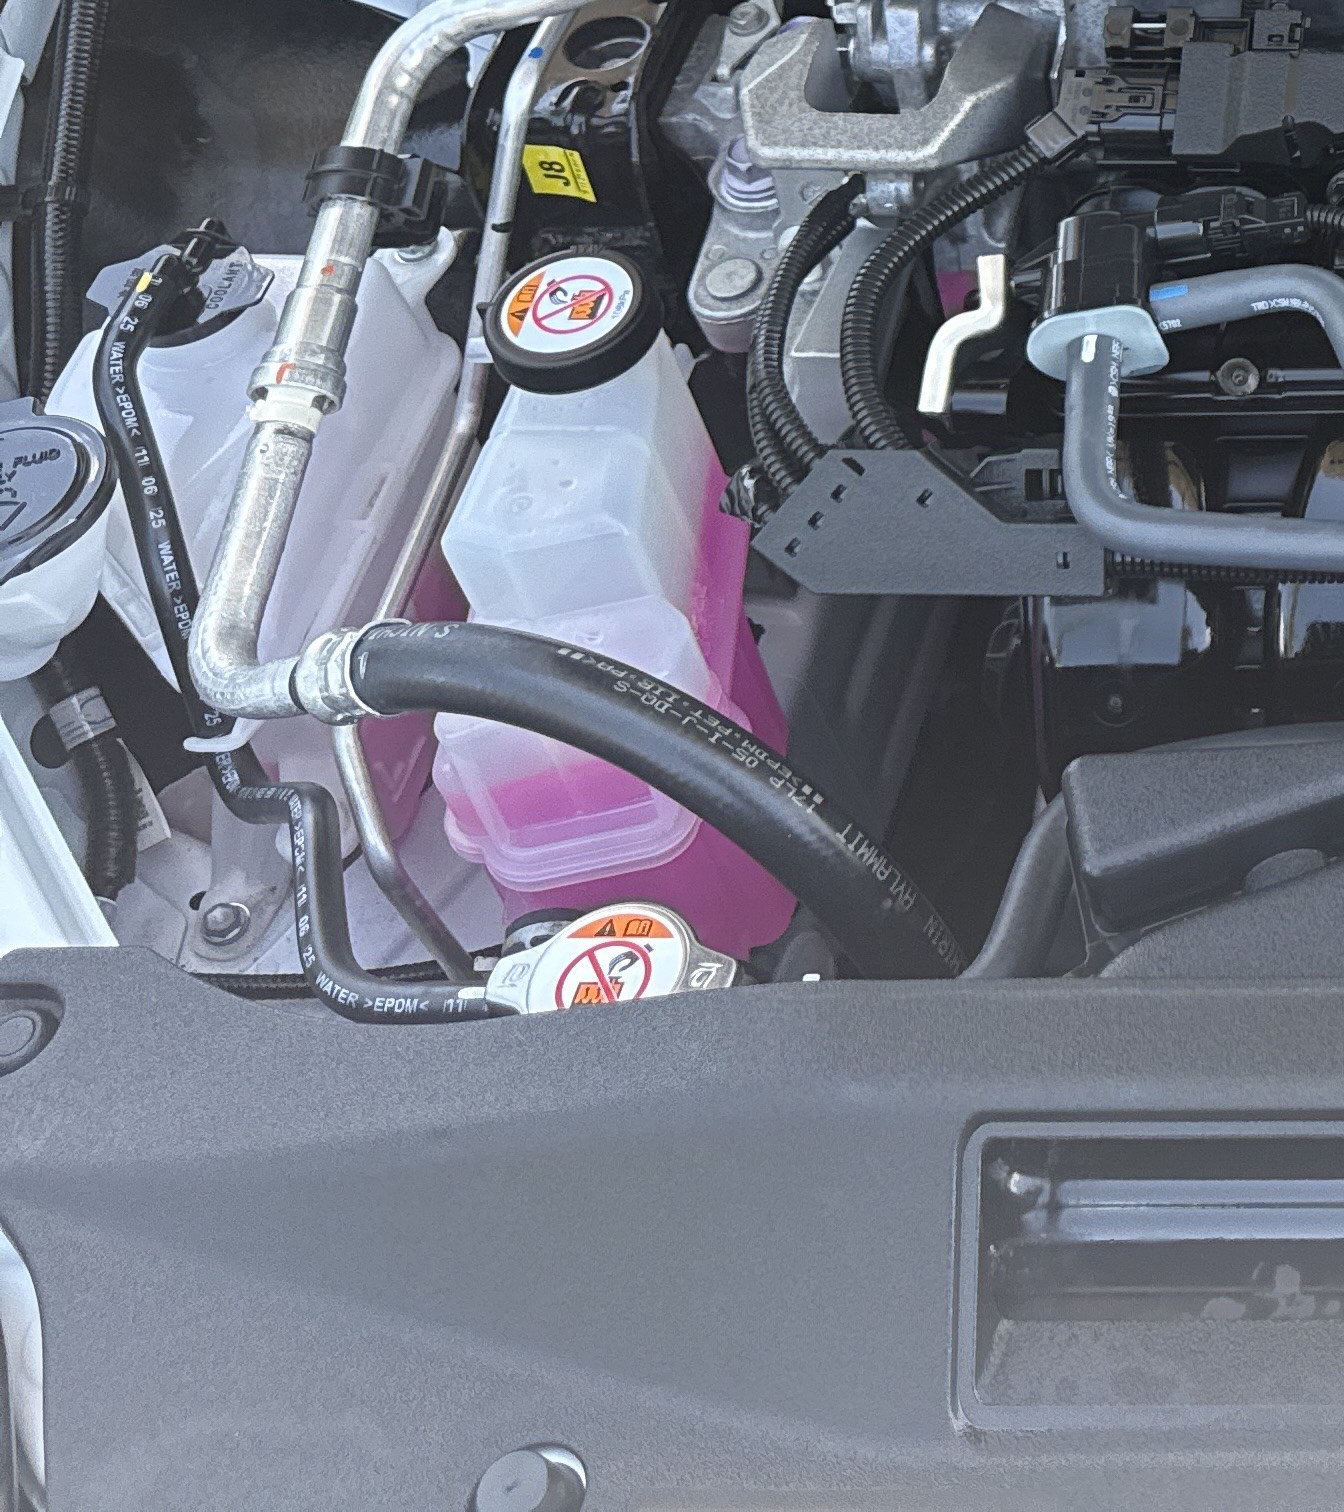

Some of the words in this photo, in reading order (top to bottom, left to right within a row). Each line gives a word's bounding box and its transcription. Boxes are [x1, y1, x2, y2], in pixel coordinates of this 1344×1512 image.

[538, 159, 571, 187] J8
[205, 261, 245, 311] COOLANT
[119, 315, 140, 333] 25
[108, 341, 126, 385] WATER
[12, 448, 61, 468] FLUID
[141, 476, 159, 496] 06
[149, 508, 167, 530] 25
[157, 539, 182, 594] WATER
[298, 914, 311, 938] 06
[302, 945, 317, 969] 25
[315, 971, 360, 1008] WATER
[363, 997, 430, 1014] >EPDM<
